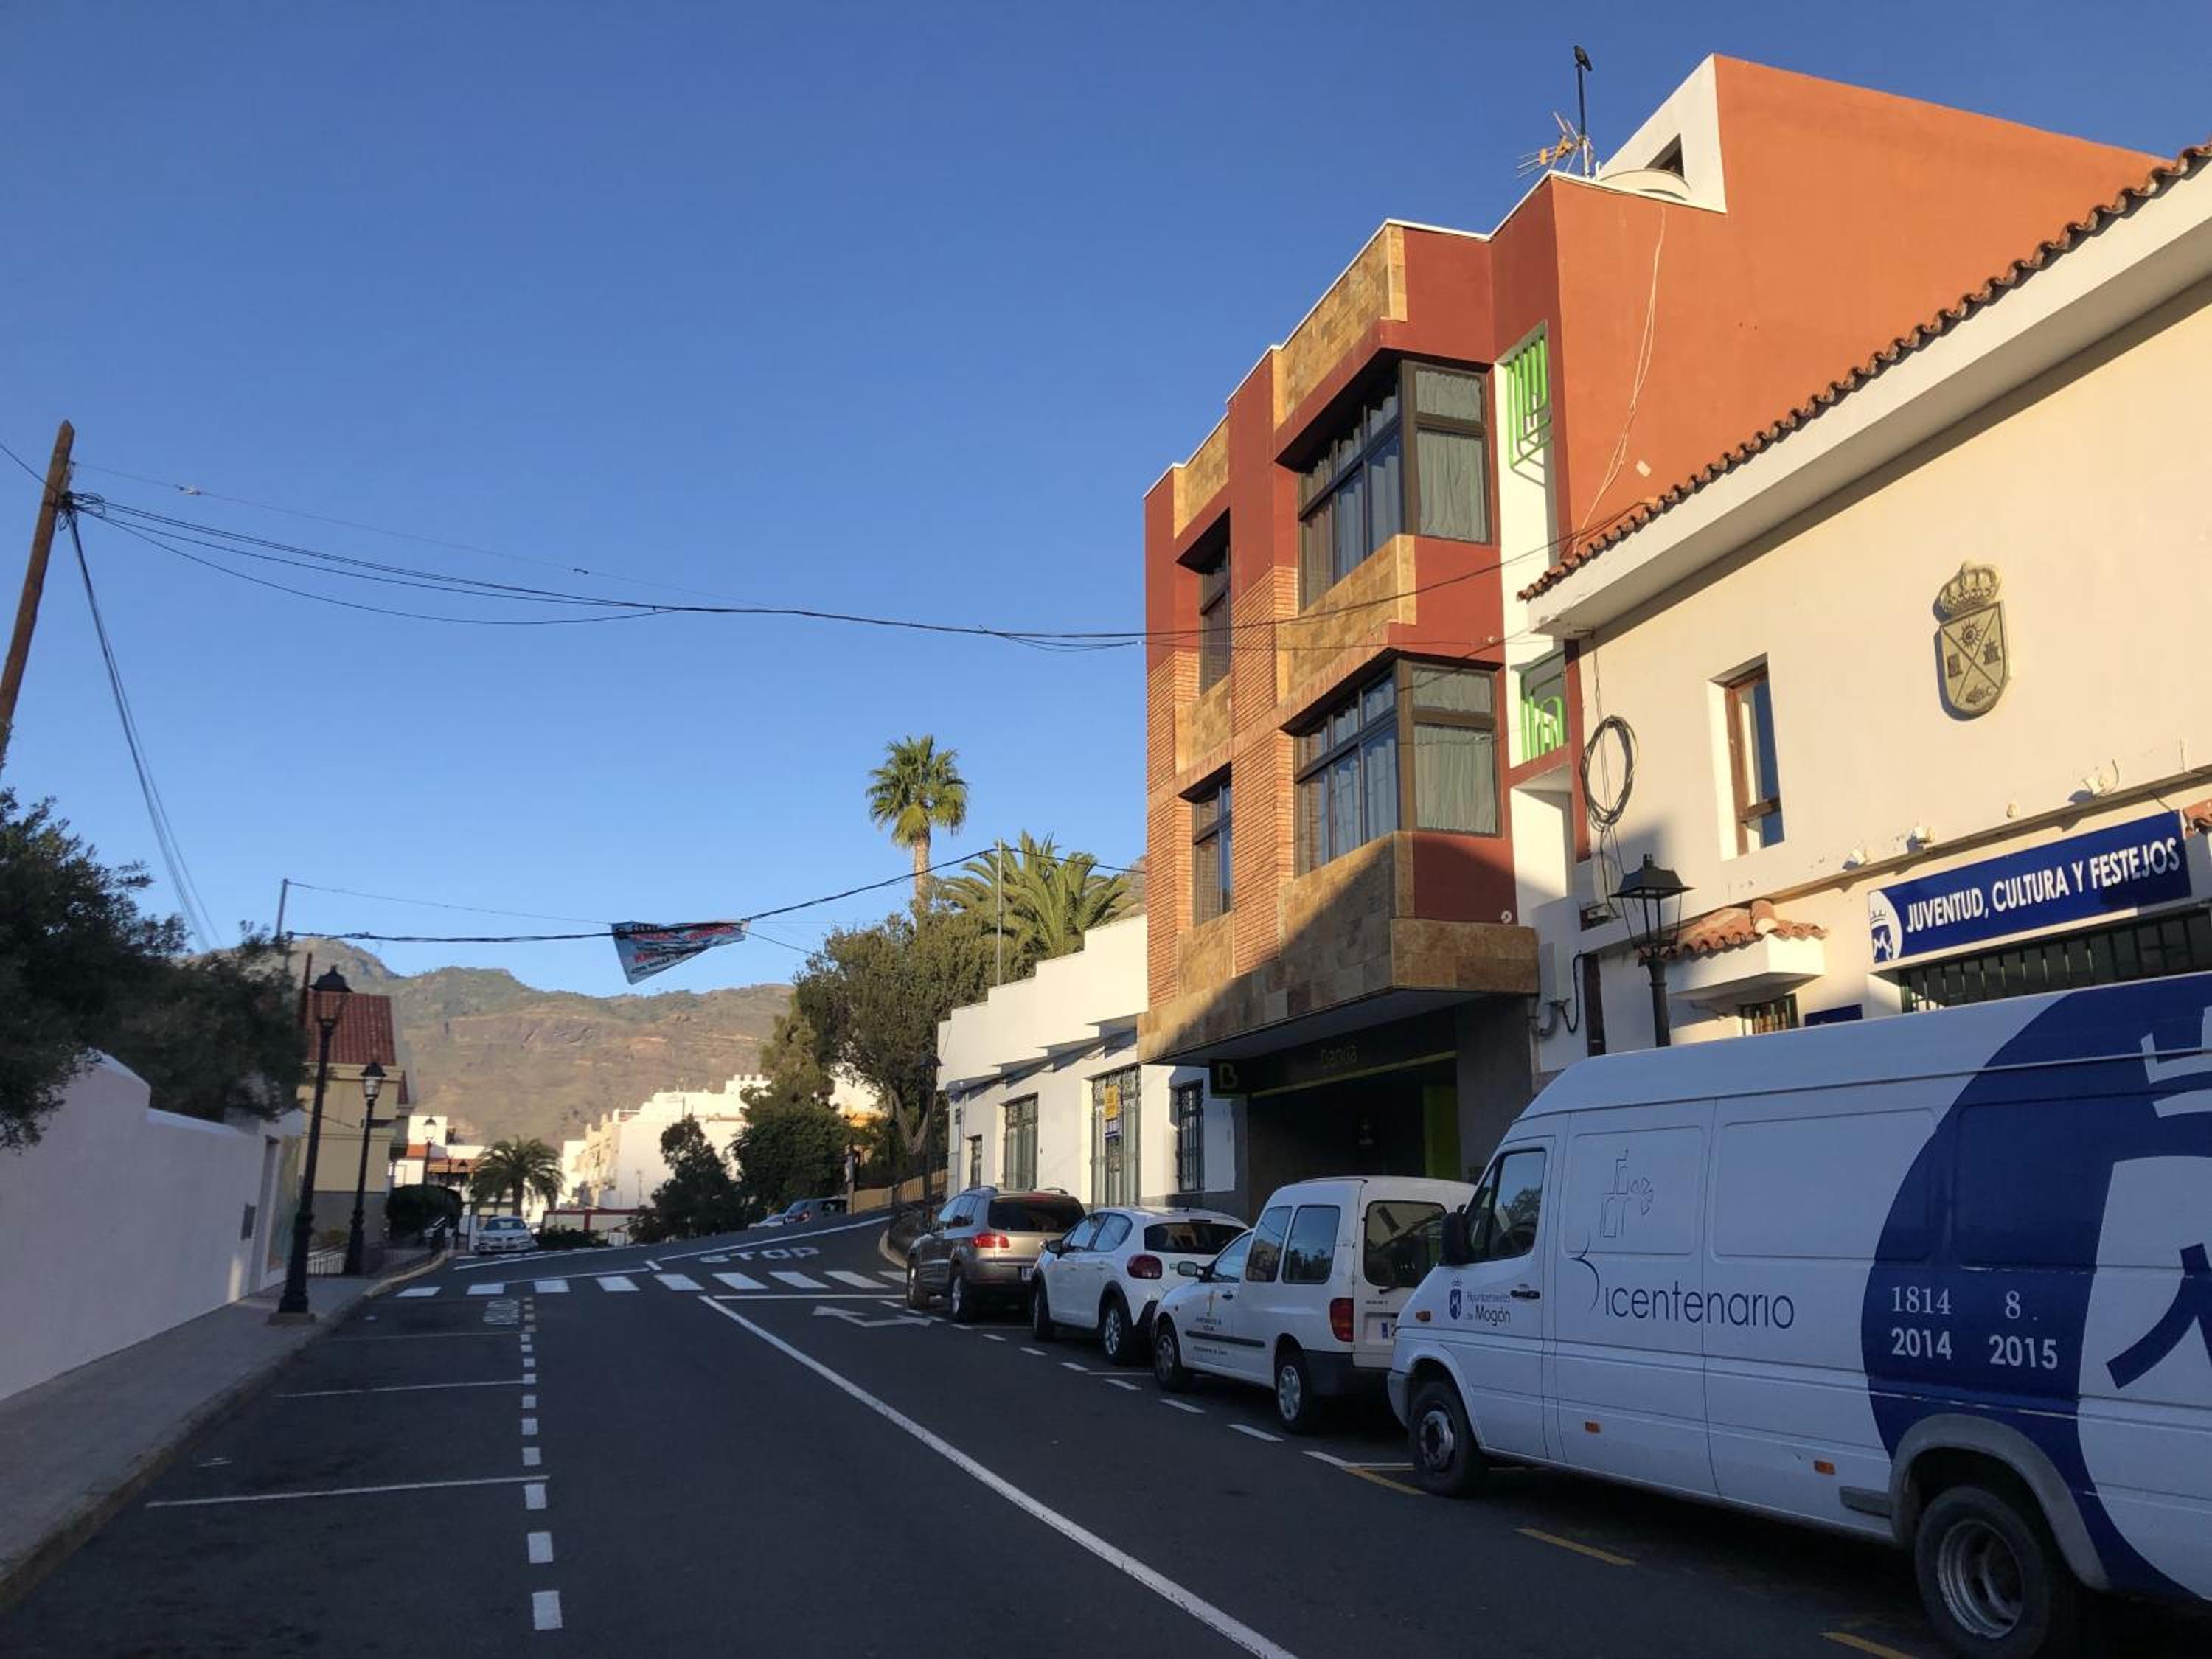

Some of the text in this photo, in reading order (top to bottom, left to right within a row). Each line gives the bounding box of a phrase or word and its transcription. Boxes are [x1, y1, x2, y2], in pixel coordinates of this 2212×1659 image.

[1906, 837, 2180, 933] JUVENTUD, CULTURA Y FESTEJOS
[1891, 1285, 1952, 1315] 1814
[1891, 1327, 2059, 1370] 2014 2015
